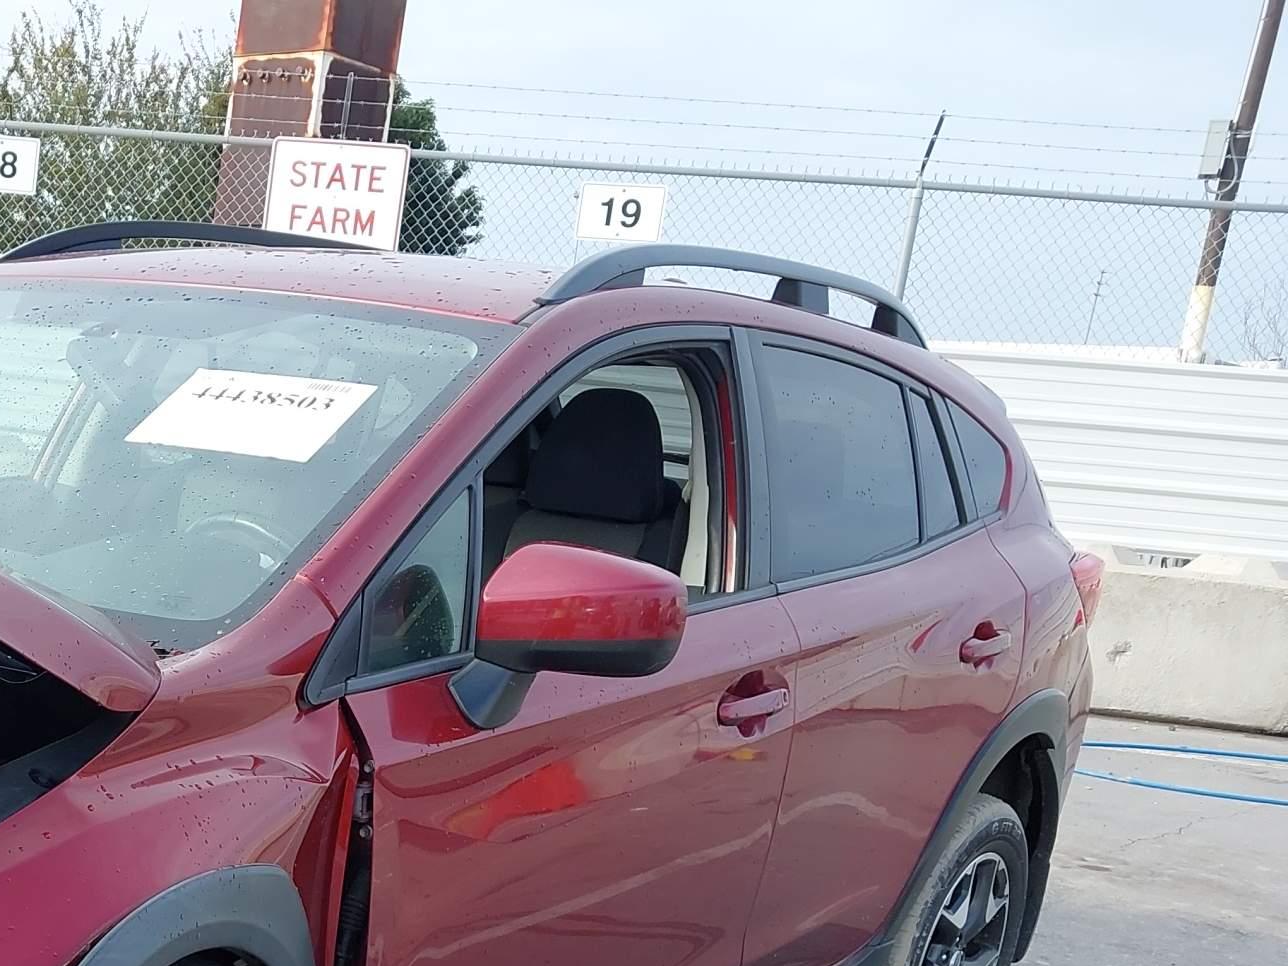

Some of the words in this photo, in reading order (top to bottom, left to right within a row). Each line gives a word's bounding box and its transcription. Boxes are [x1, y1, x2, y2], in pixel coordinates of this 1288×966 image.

[289, 160, 387, 193] STATE
[288, 204, 376, 237] FARM
[600, 197, 642, 228] 19
[192, 385, 335, 411] 44438503
